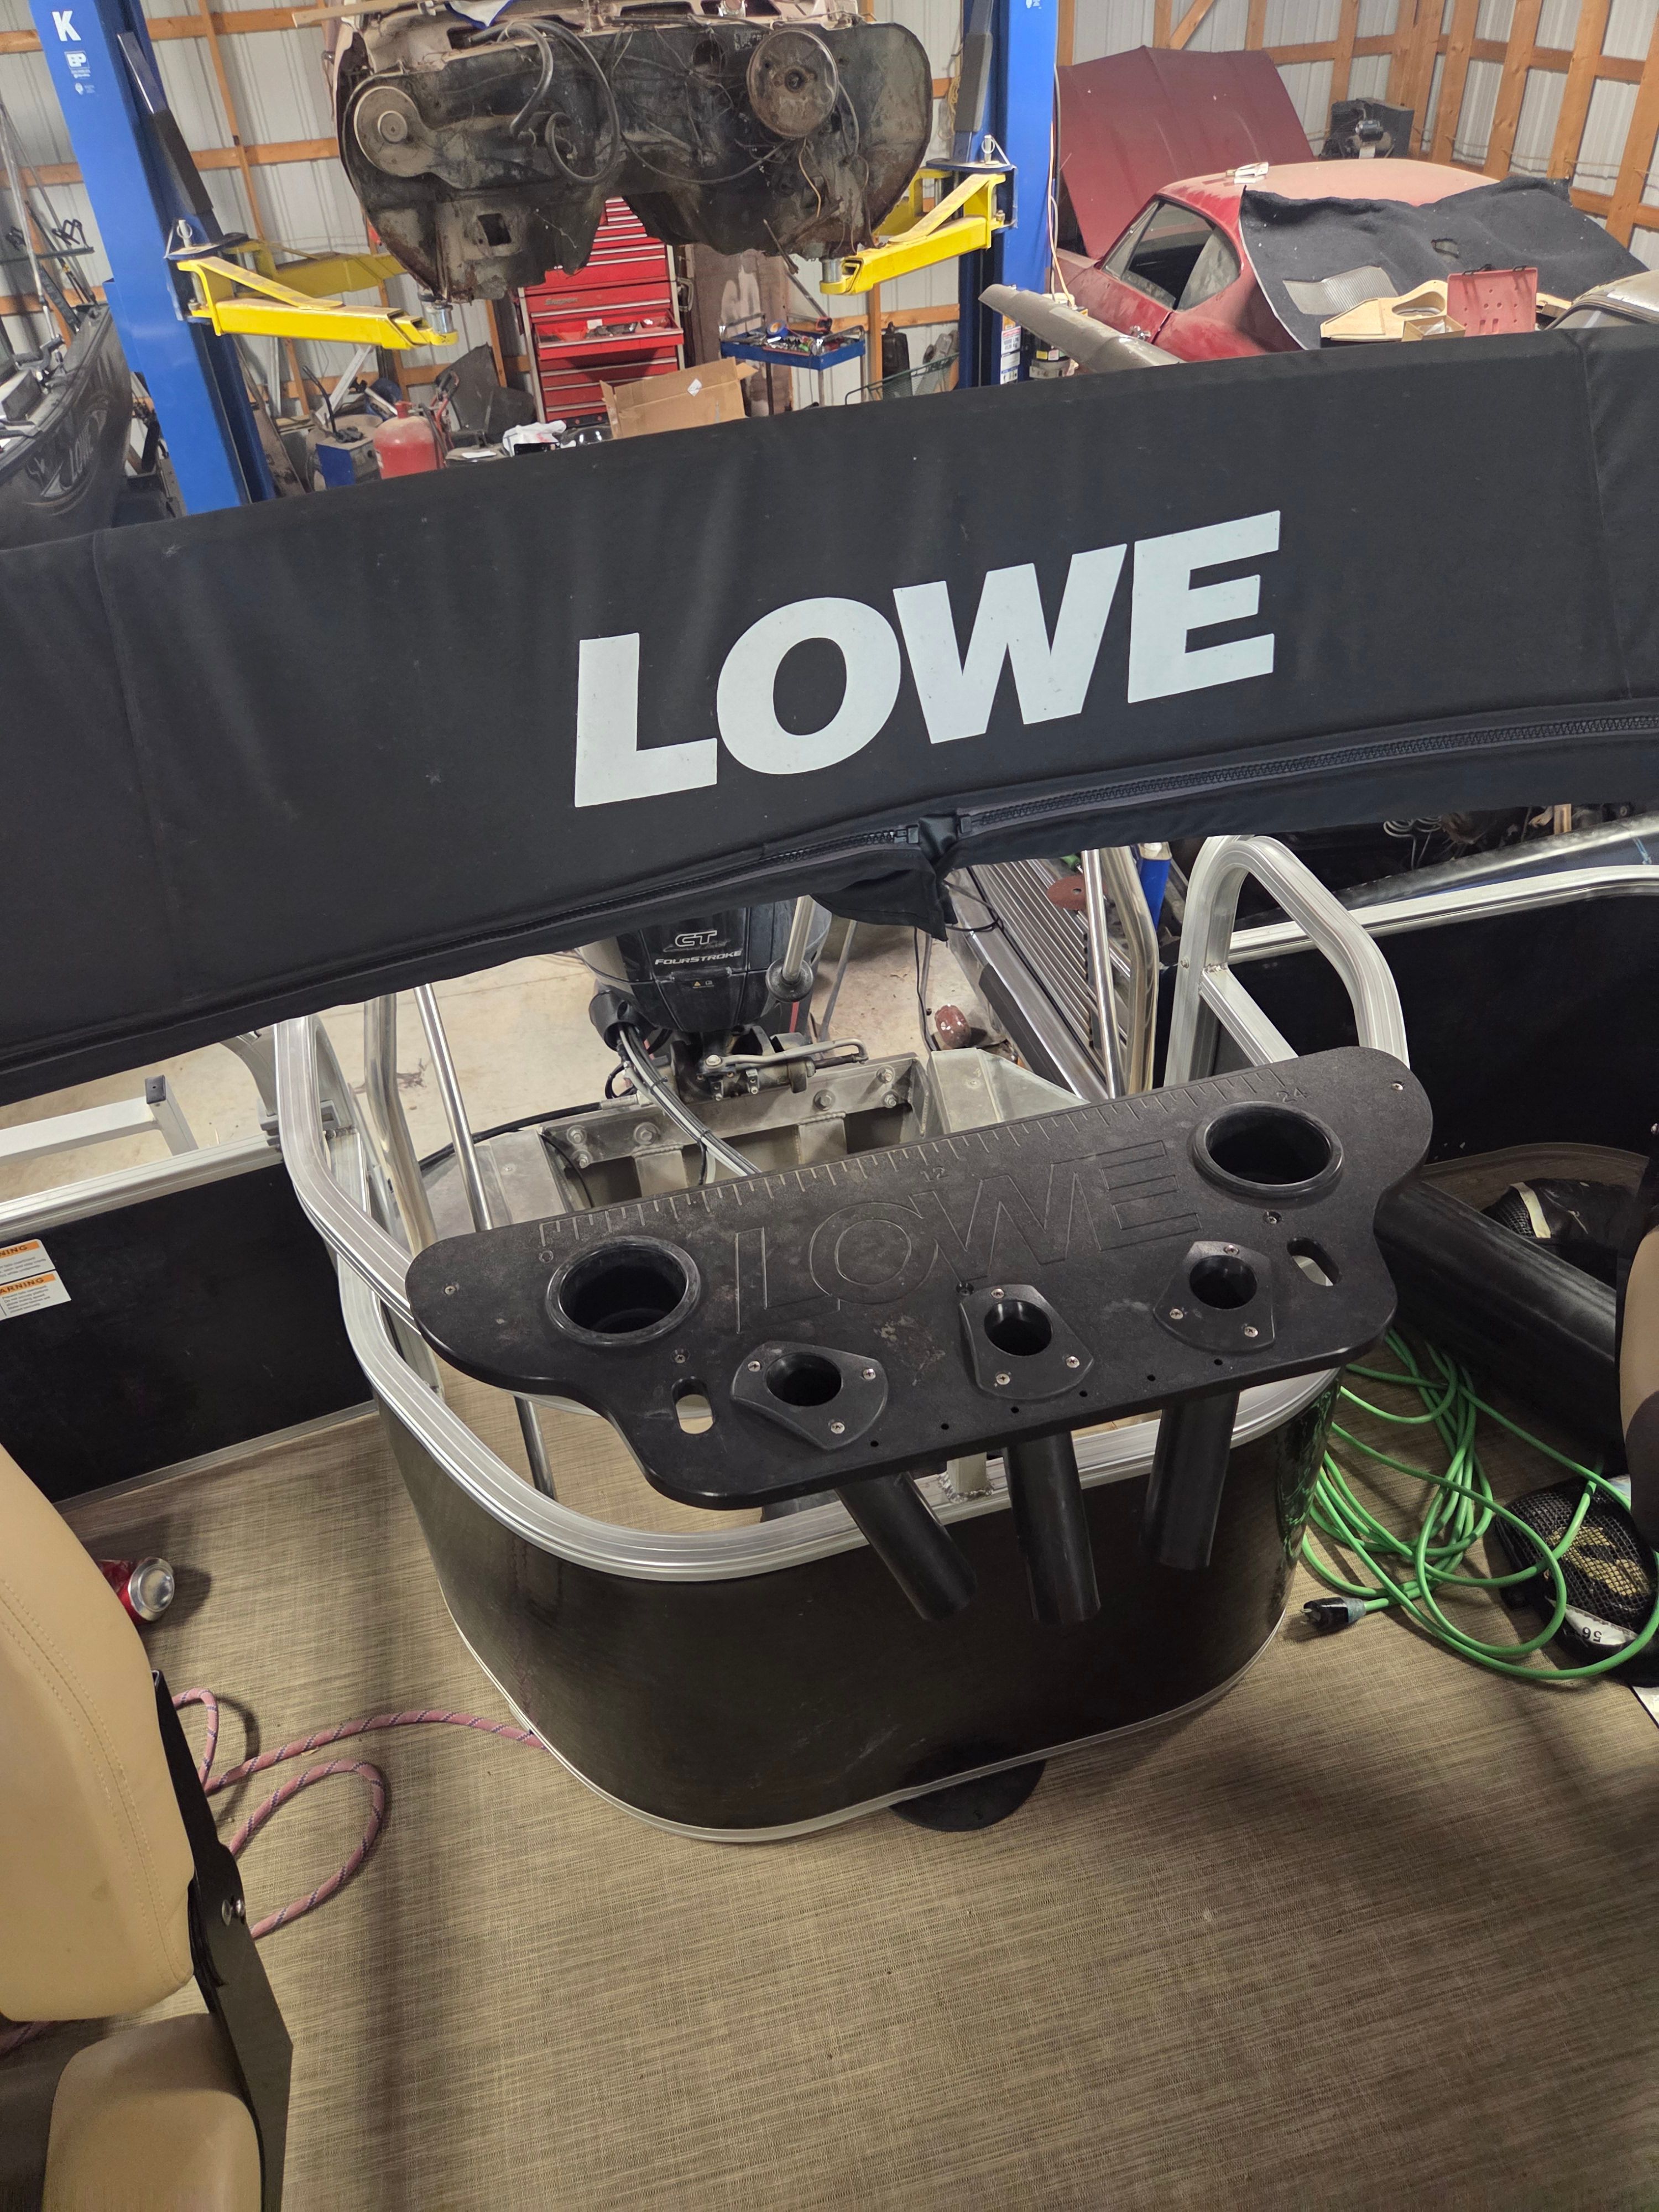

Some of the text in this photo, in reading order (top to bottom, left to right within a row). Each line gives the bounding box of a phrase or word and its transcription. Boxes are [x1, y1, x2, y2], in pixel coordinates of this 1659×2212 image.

[52, 11, 81, 41] K
[574, 510, 1281, 807] LOWE
[675, 930, 717, 947] CT
[1276, 1087, 1308, 1104] 24
[920, 1166, 950, 1182] 12
[735, 1139, 1203, 1334] LOWE
[1582, 1627, 1602, 1642] 56
